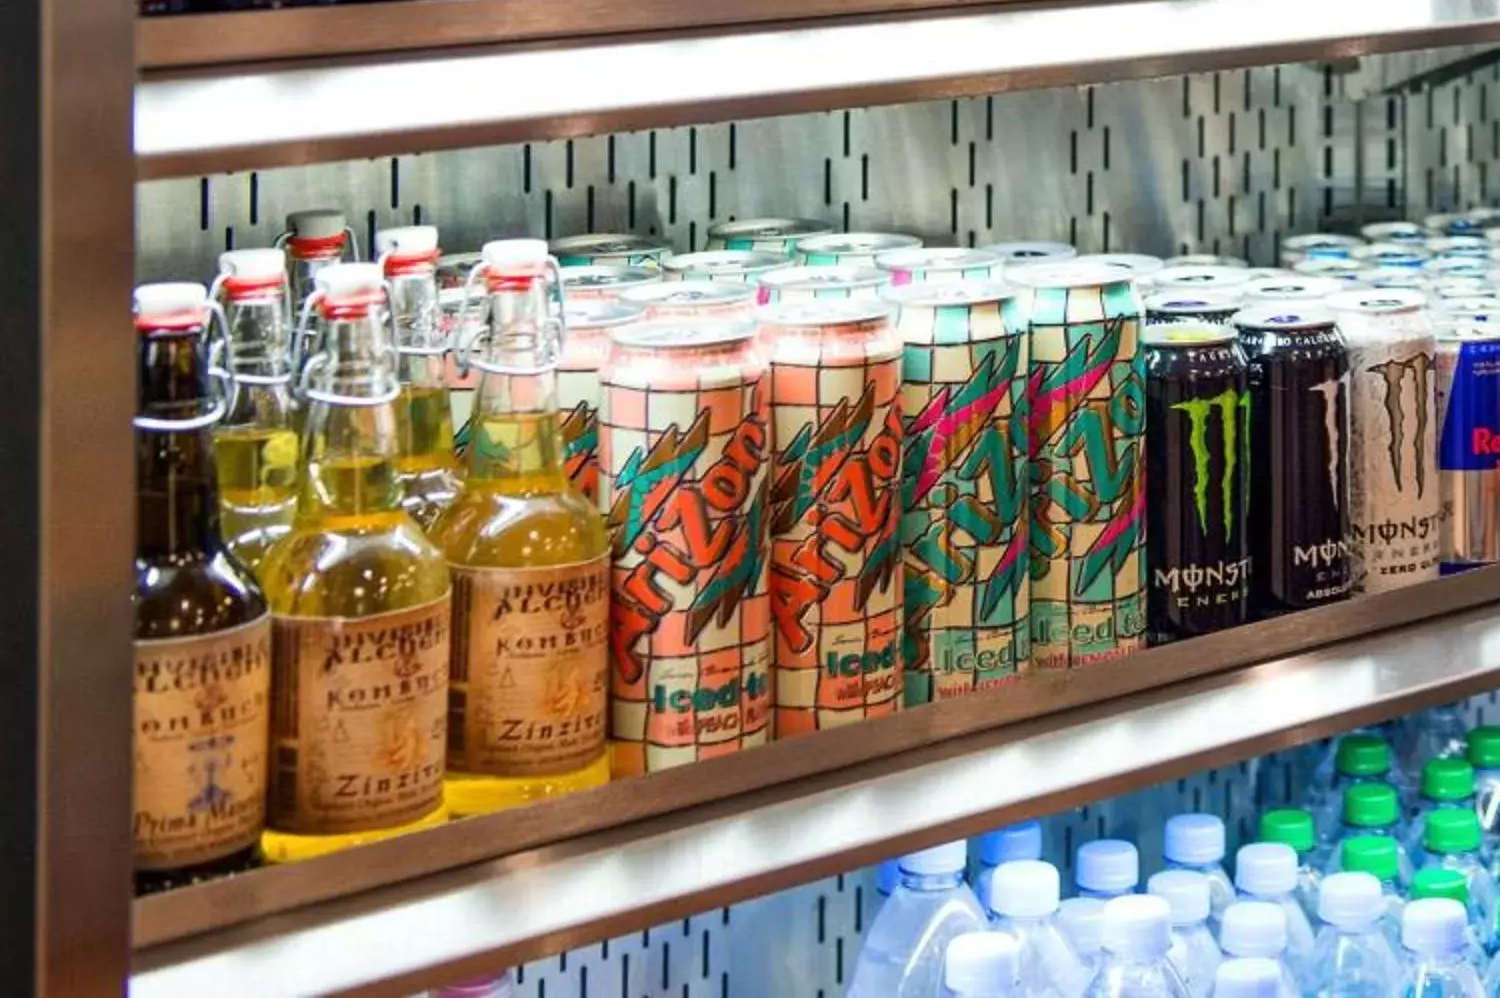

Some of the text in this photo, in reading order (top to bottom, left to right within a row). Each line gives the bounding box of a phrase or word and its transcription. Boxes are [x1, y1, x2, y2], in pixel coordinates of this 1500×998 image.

[1154, 558, 1251, 593] MONST
[1036, 617, 1114, 645] Iced
[652, 677, 739, 714] Iced
